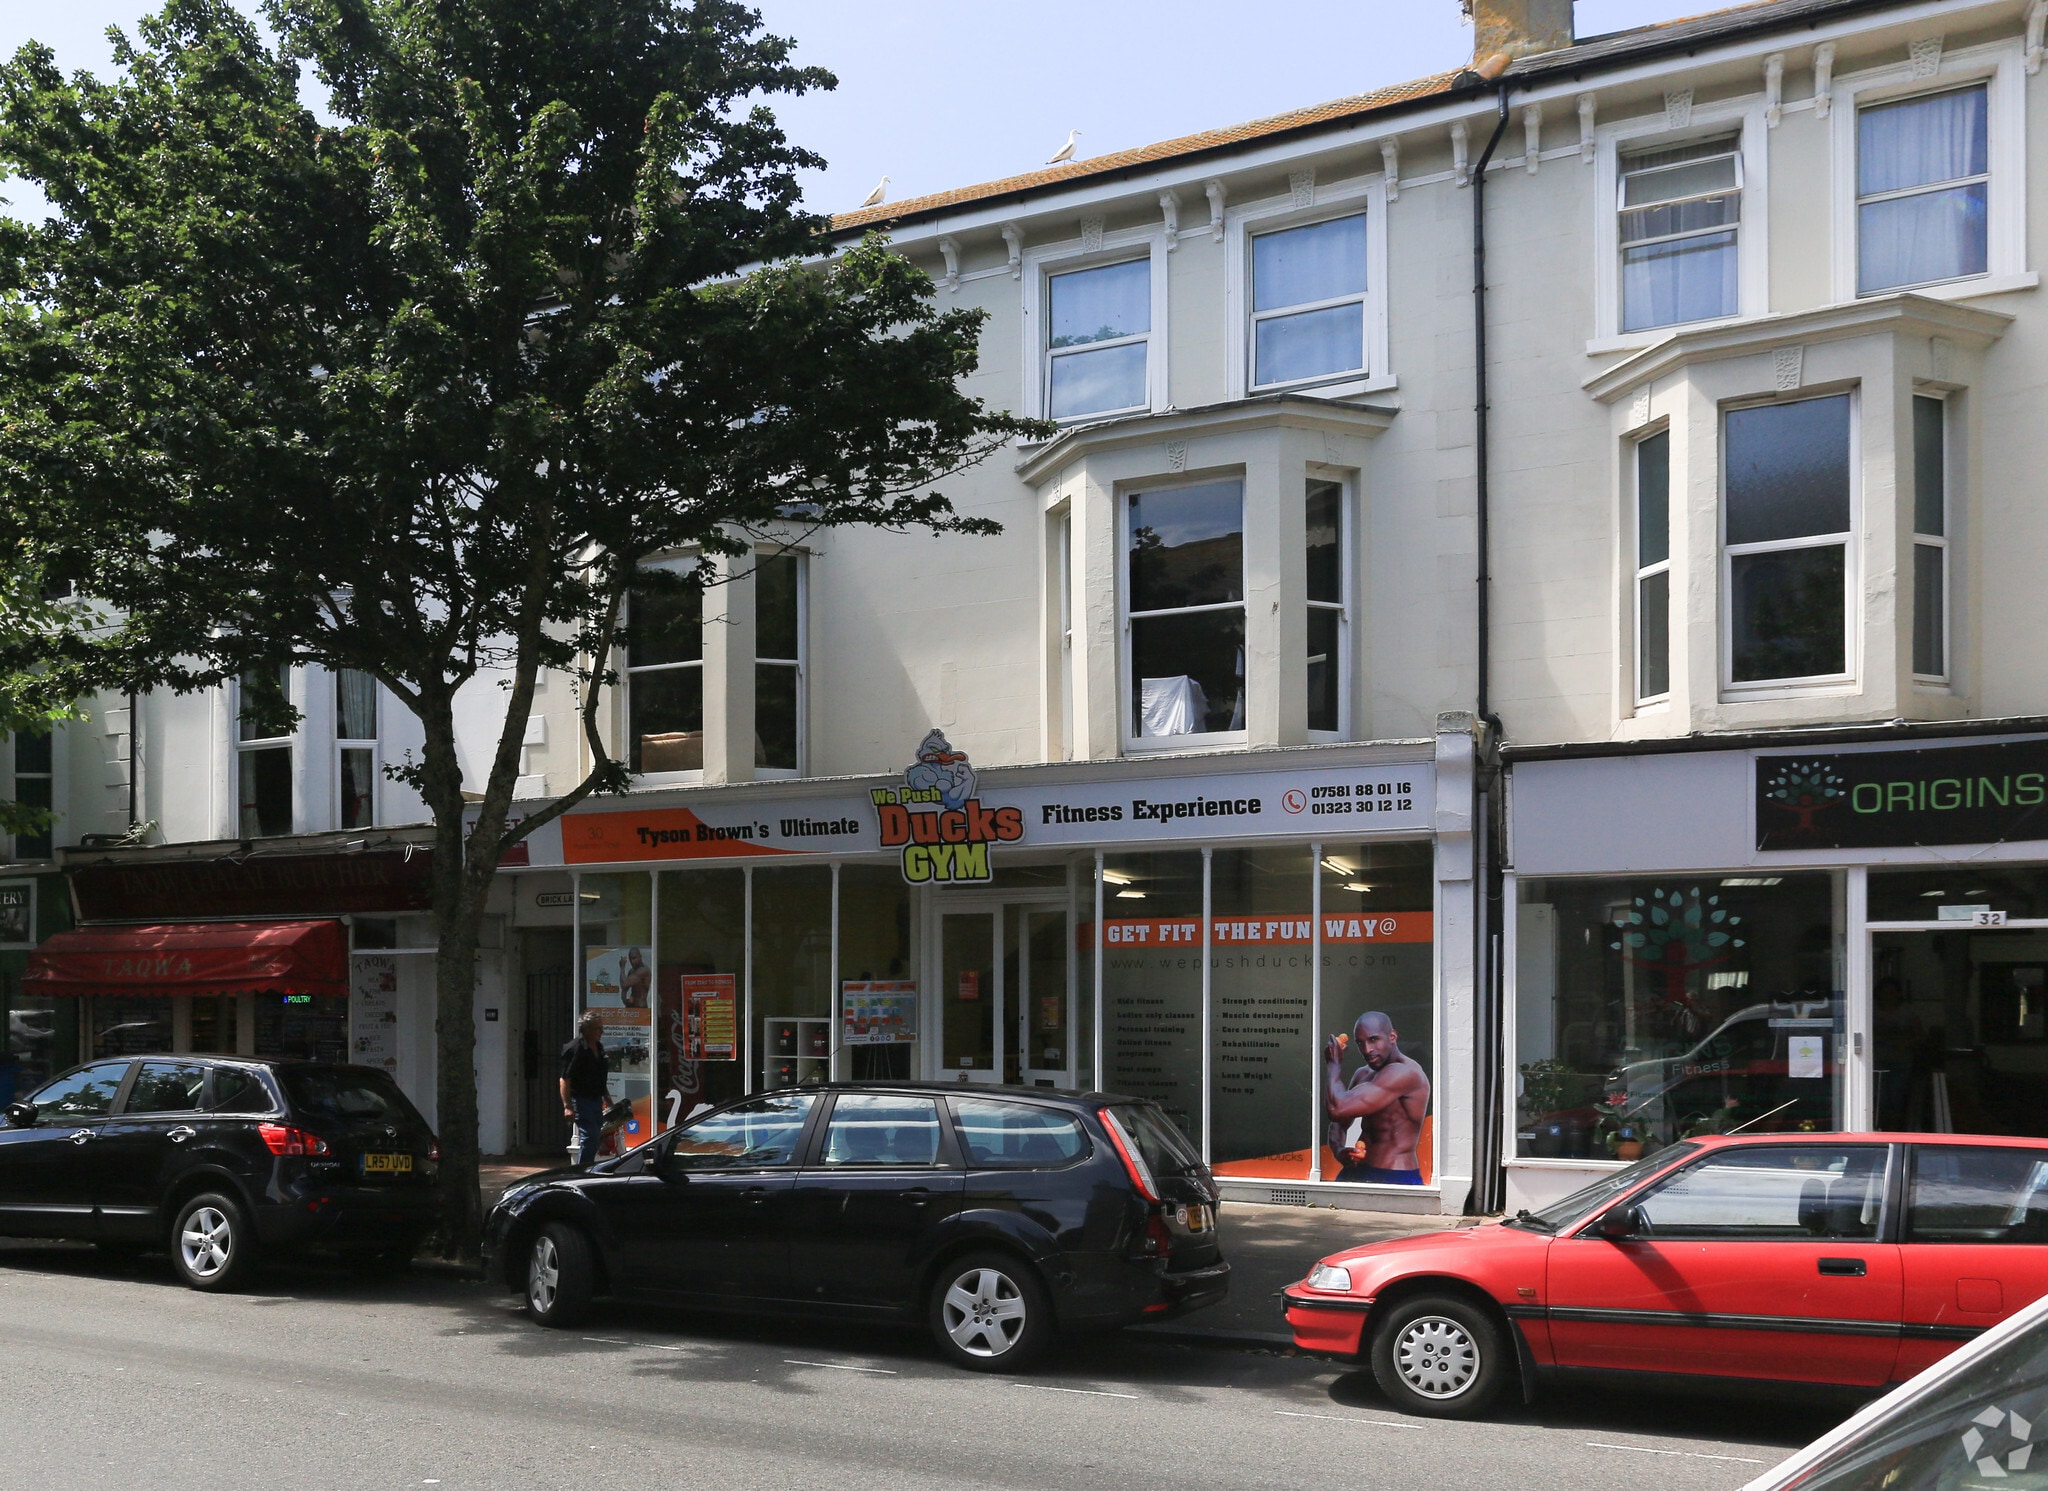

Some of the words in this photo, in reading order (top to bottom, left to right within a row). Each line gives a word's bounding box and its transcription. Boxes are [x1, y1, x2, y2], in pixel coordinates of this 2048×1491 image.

[871, 789, 897, 805] We
[900, 785, 943, 804] Push
[1311, 784, 1351, 799] 07581
[1355, 783, 1374, 797] 88
[1377, 782, 1392, 796] 01
[1396, 781, 1412, 795] 16
[1851, 772, 2046, 814] ORIGINS
[1041, 803, 1123, 825] Fitness
[1132, 796, 1262, 824] Experience
[1311, 801, 1353, 815] 01323
[1356, 800, 1374, 814] 30
[1378, 799, 1393, 812] 12
[1397, 798, 1412, 812] 12
[878, 799, 1024, 846] Ducks
[637, 826, 691, 848] Tyson
[695, 820, 770, 841] Brown's
[780, 816, 860, 838] Ultimate
[903, 844, 989, 883] GYM
[274, 858, 391, 889] BUTCHER
[1979, 912, 2001, 926] 32
[1107, 924, 1151, 943] GET
[1158, 923, 1196, 942] FIT
[1214, 921, 1262, 940] THE
[1265, 920, 1311, 940] FUN
[103, 956, 194, 978] TAQWA
[355, 956, 395, 974] TAQWA
[287, 995, 312, 1004] POULTRY
[1221, 997, 1256, 1006] Strength
[1258, 997, 1308, 1006] conditioning
[1252, 1012, 1304, 1020] development
[1242, 1026, 1300, 1035] strengthening
[1221, 1040, 1280, 1048] Rehabilitation
[1240, 1055, 1268, 1064] tummy
[1671, 1060, 1730, 1075] Fitness
[1243, 1072, 1273, 1080] Weight
[366, 1155, 391, 1169] LR57
[391, 1155, 411, 1169] UVD
